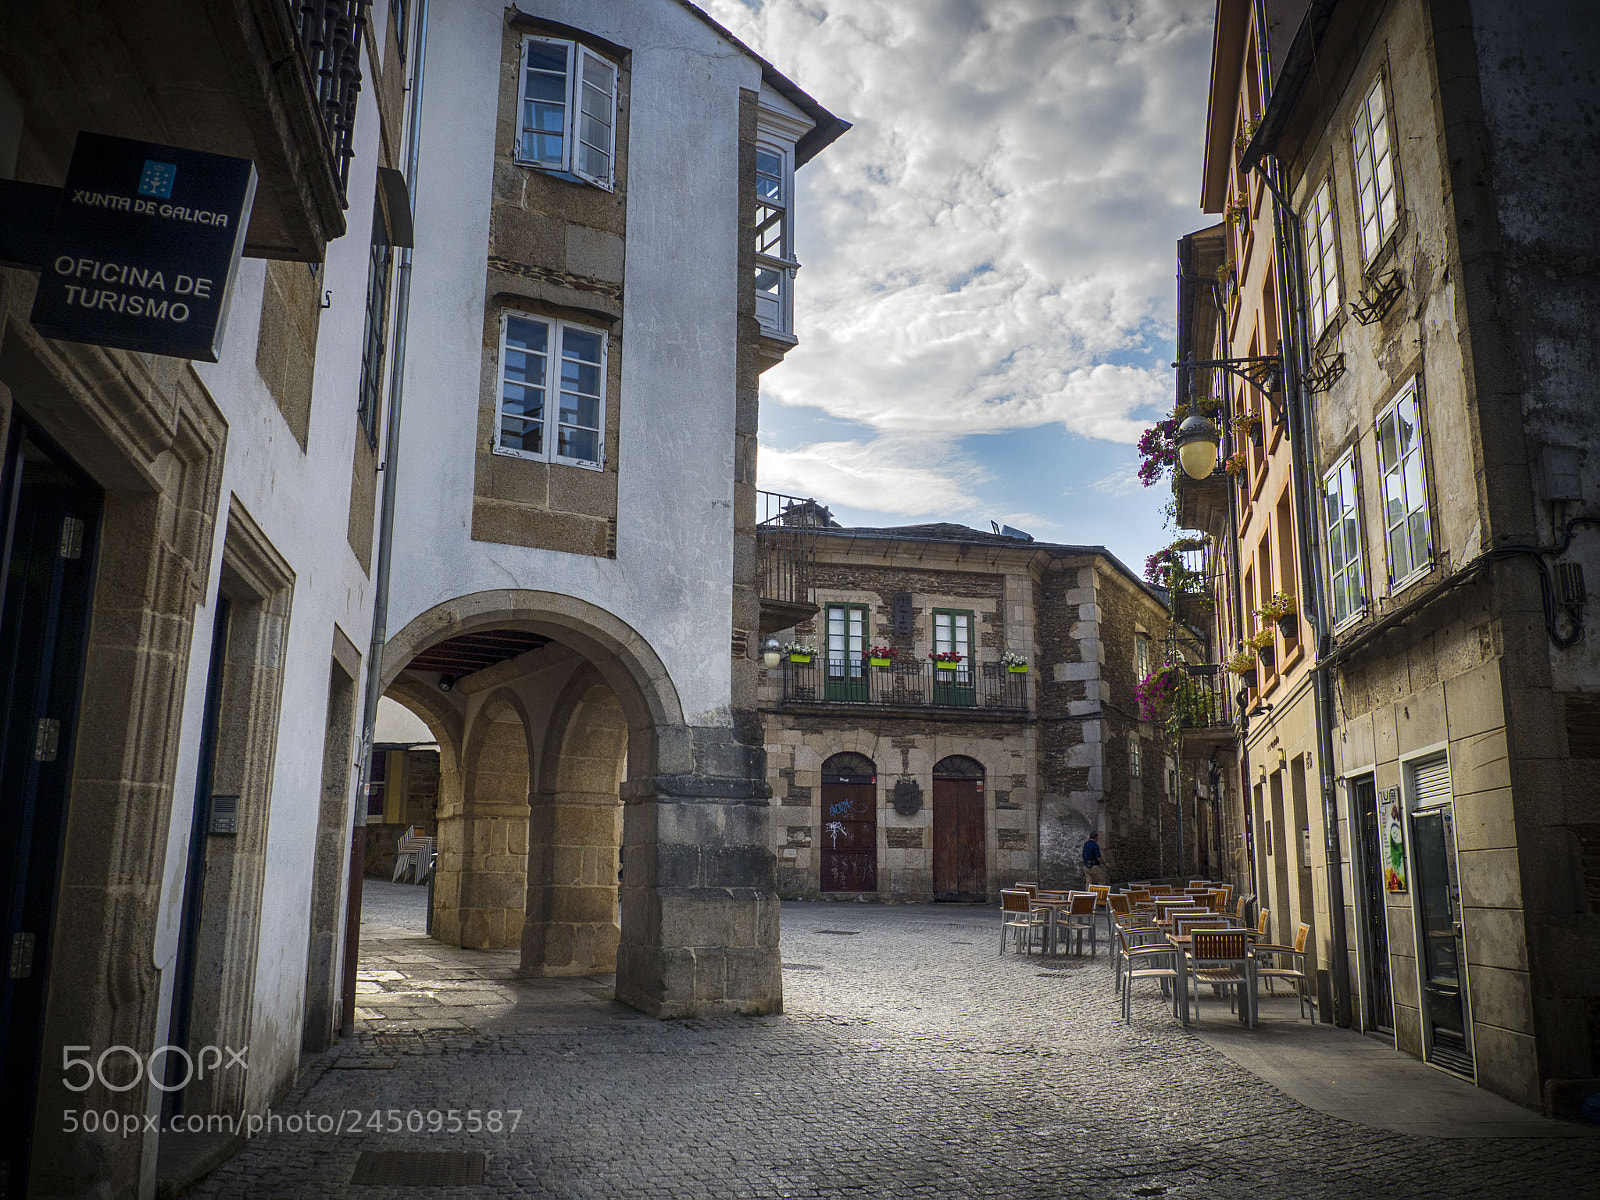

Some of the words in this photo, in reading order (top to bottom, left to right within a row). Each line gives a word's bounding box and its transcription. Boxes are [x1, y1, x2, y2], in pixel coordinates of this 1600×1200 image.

[71, 189, 130, 211] XUNTA
[134, 199, 159, 214] DE
[159, 204, 228, 228] GALICIA
[54, 256, 166, 291] OFICINA
[174, 275, 213, 299] DE
[65, 284, 190, 323] TURISMO
